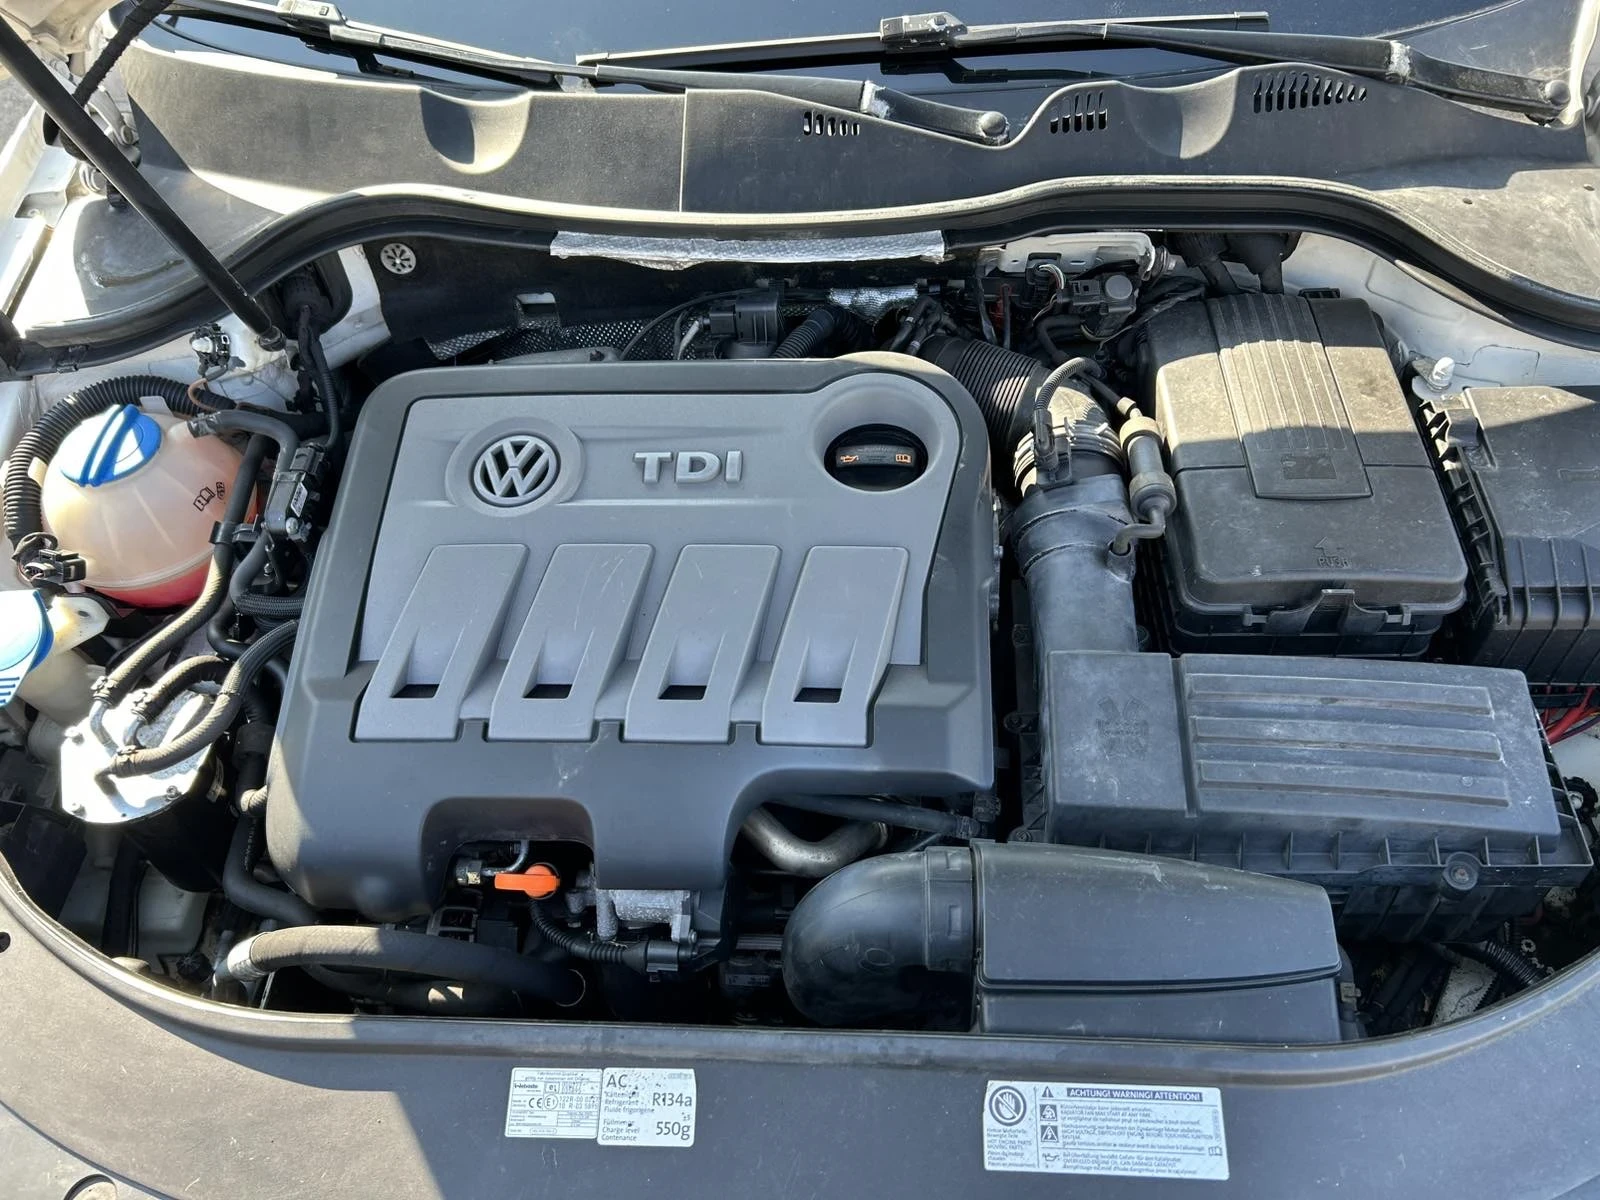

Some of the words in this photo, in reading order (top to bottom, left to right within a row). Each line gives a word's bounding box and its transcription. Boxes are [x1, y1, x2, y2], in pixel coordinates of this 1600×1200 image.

[633, 450, 743, 484] TDI
[606, 1074, 628, 1088] AC
[652, 1092, 692, 1107] R134a
[1069, 1088, 1111, 1098] ACHTUNG!
[1112, 1090, 1153, 1099] WARNING!
[1154, 1091, 1200, 1101] ATTENTION!
[602, 1126, 624, 1135] Charge
[656, 1121, 691, 1140] 550g
